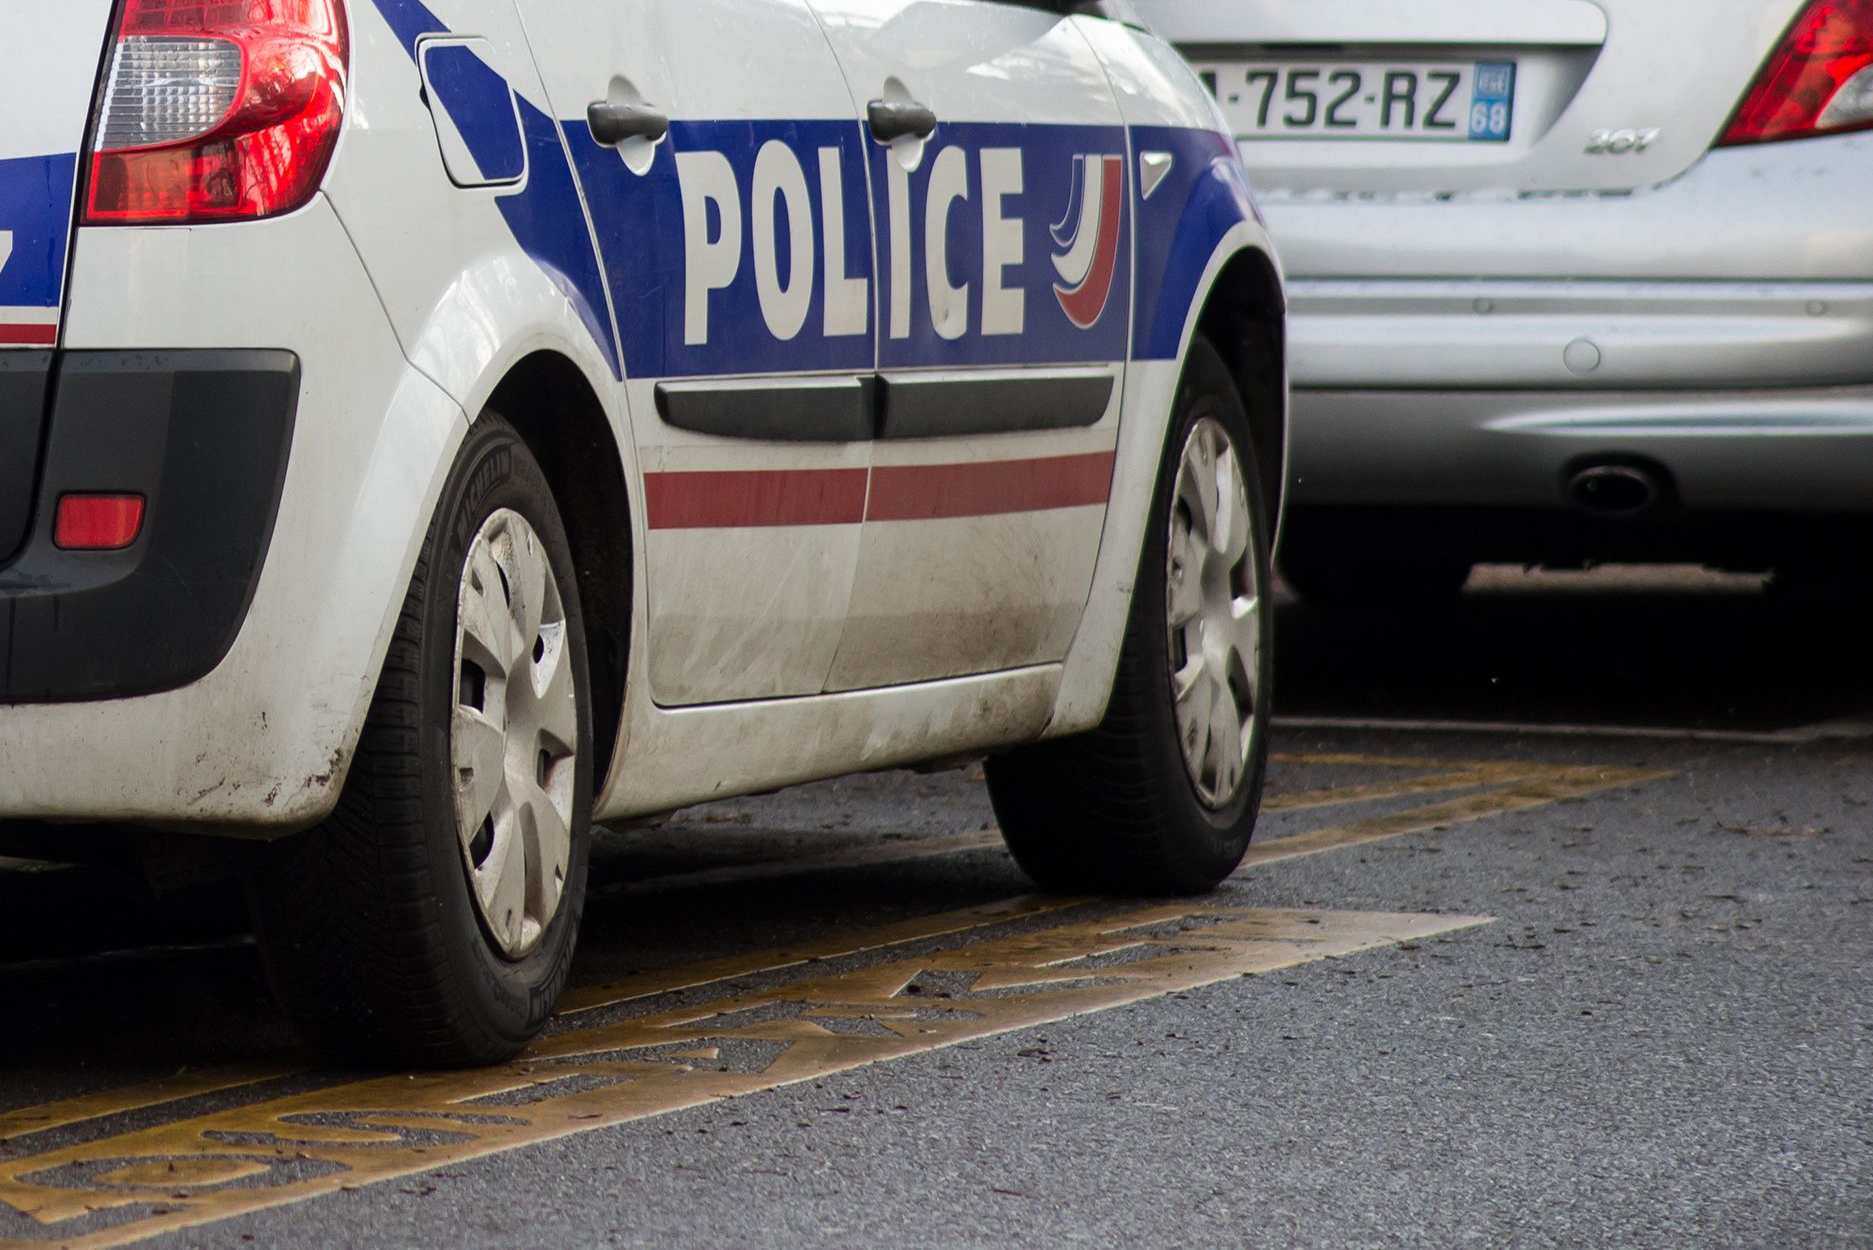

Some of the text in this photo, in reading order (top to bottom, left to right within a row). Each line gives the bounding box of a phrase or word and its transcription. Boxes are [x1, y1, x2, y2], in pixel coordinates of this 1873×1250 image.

[1470, 102, 1507, 134] 68
[1583, 127, 1662, 155] 207
[675, 139, 1025, 346] POLICE
